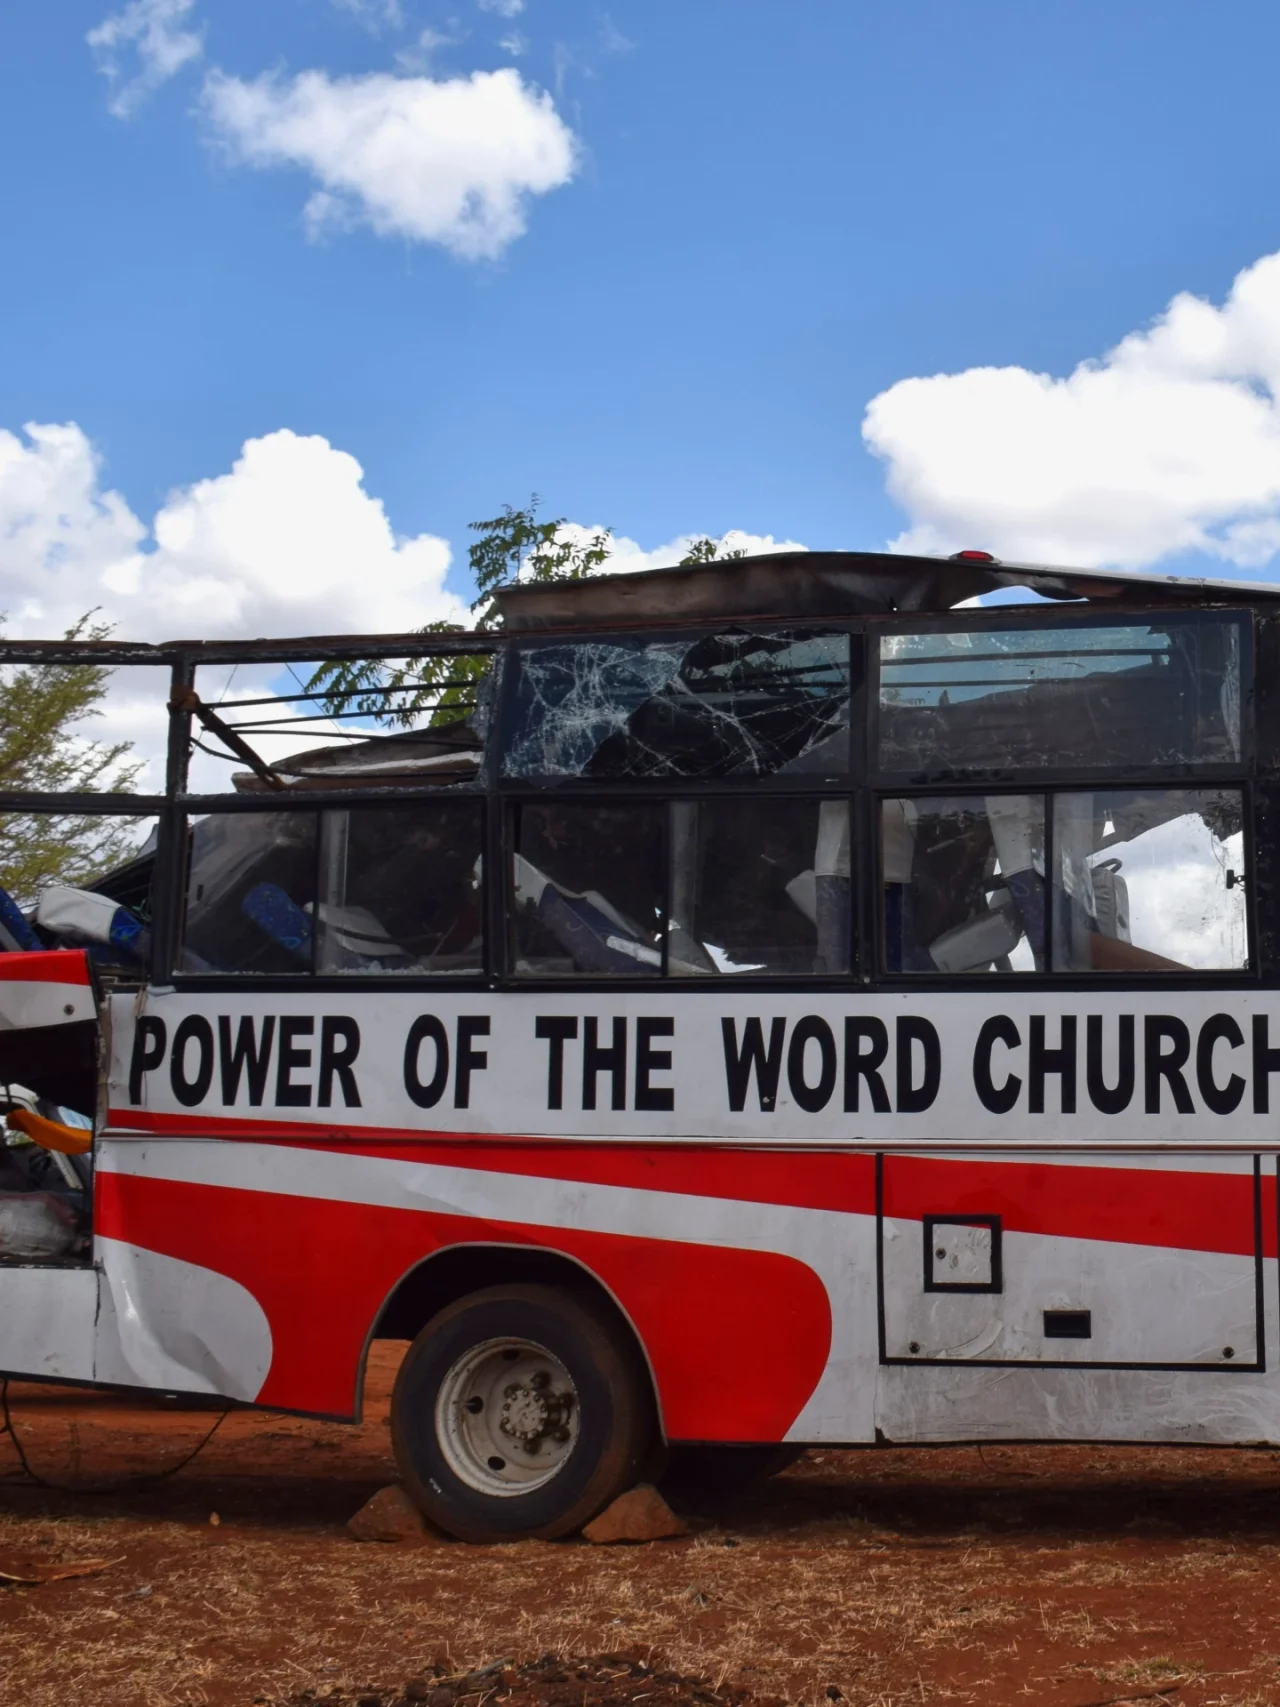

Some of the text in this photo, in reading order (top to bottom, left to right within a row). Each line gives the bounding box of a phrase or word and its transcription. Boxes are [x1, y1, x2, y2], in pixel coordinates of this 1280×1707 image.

[128, 1014, 362, 1108] POWER
[403, 1014, 491, 1109] OF
[535, 1015, 675, 1112] THE
[721, 1015, 942, 1114] WORD
